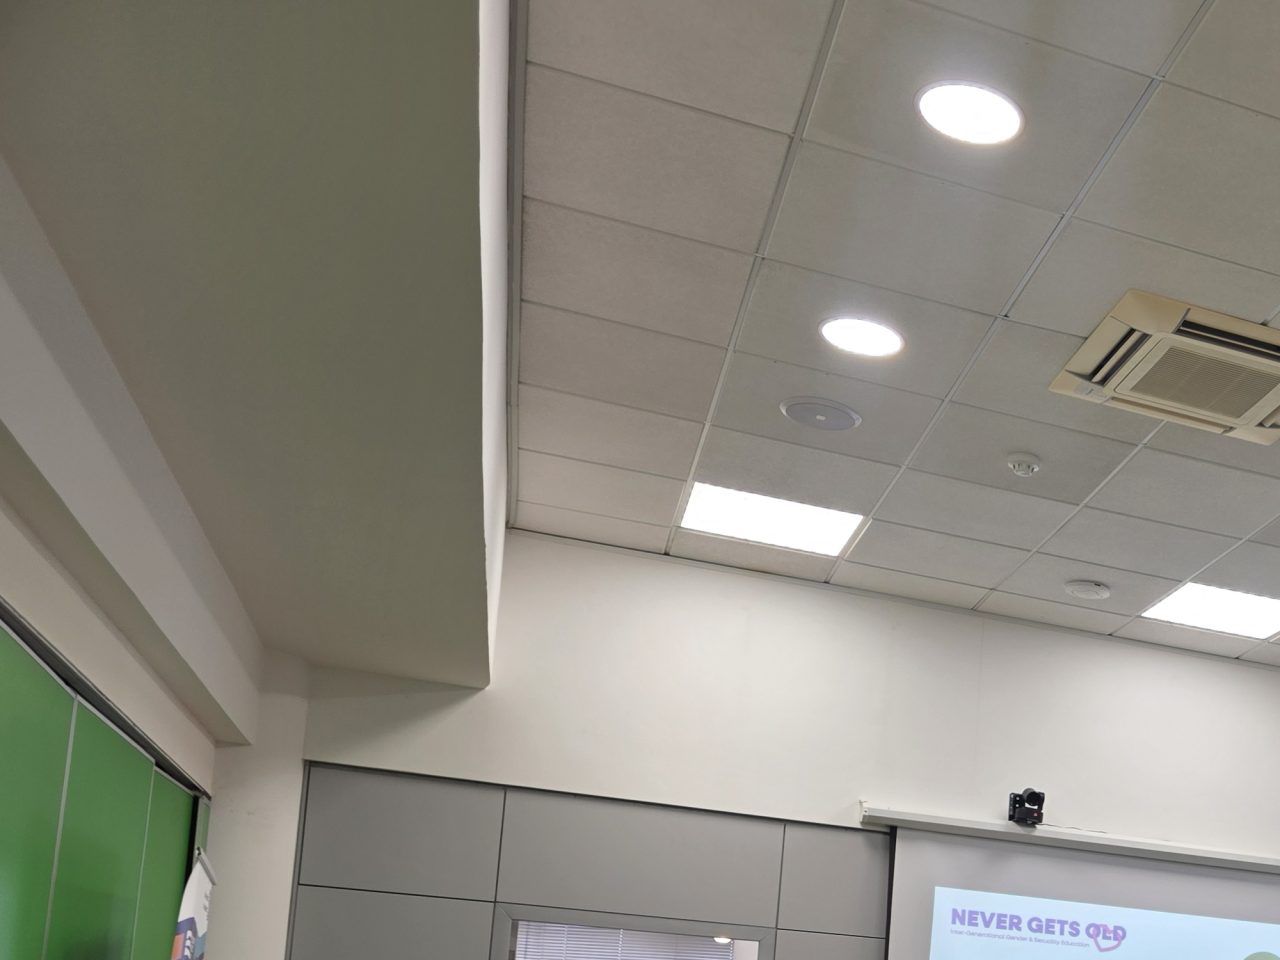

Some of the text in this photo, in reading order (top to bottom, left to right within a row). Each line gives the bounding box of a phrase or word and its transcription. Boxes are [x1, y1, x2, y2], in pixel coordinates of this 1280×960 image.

[951, 908, 1127, 942] NEVER GETS OLD
